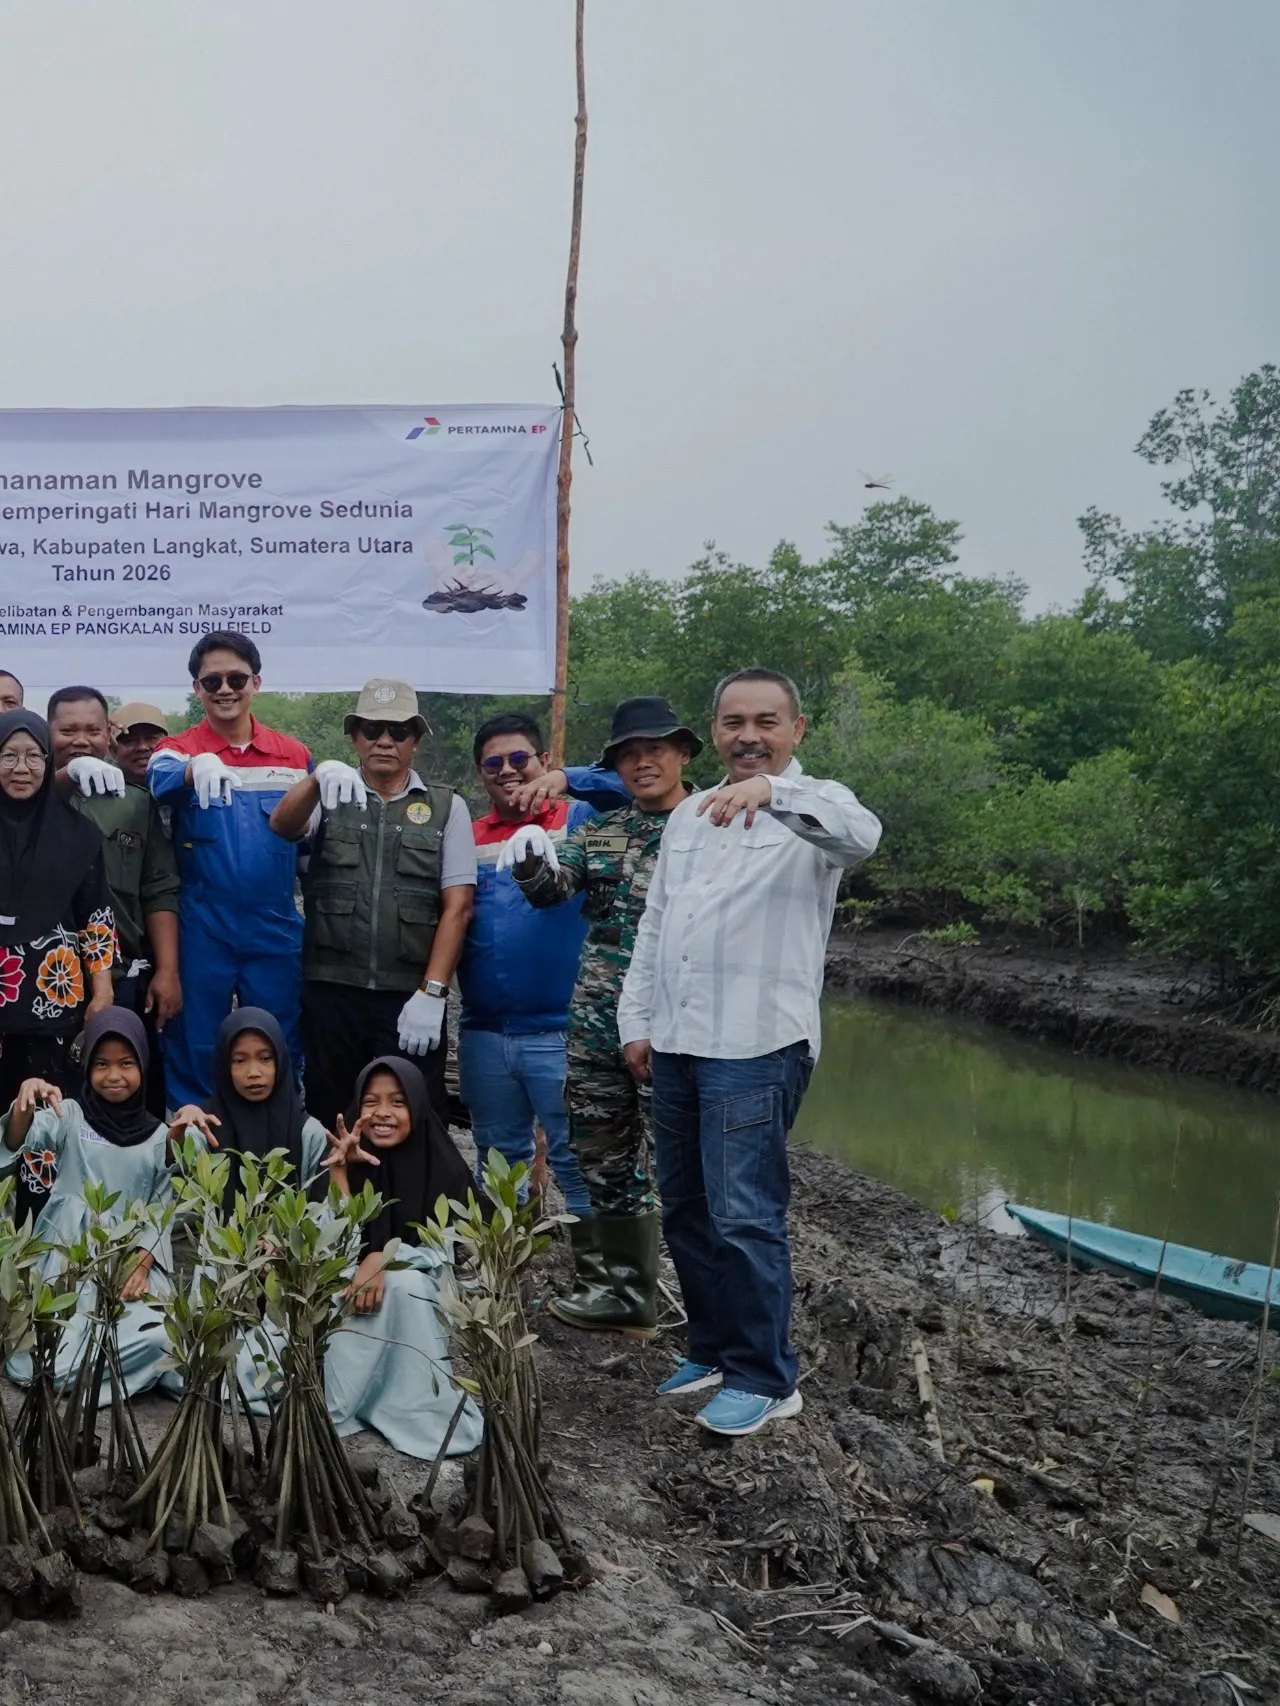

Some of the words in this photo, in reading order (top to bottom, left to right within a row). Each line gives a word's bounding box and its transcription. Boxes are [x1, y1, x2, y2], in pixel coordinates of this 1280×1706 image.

[448, 425, 527, 435] PERTAMINA
[531, 425, 548, 434] EP
[127, 469, 263, 494] Mangrove
[145, 501, 191, 520] Hari
[199, 501, 313, 524] Mangrove
[319, 499, 413, 519] Sedunia
[32, 537, 146, 560] Kabupaten
[153, 537, 243, 559] Langkat,
[249, 536, 351, 554] Sumatera
[357, 536, 414, 555] Utara
[51, 564, 115, 582] Tahun
[122, 563, 171, 582] 2026
[61, 604, 73, 618] &
[77, 604, 194, 621] Pengembangan
[198, 603, 284, 620] Masyarakat
[51, 623, 72, 636] EP
[76, 621, 174, 636] PANGKALAN
[178, 621, 222, 635] SUSU
[227, 621, 272, 634] FIELD
